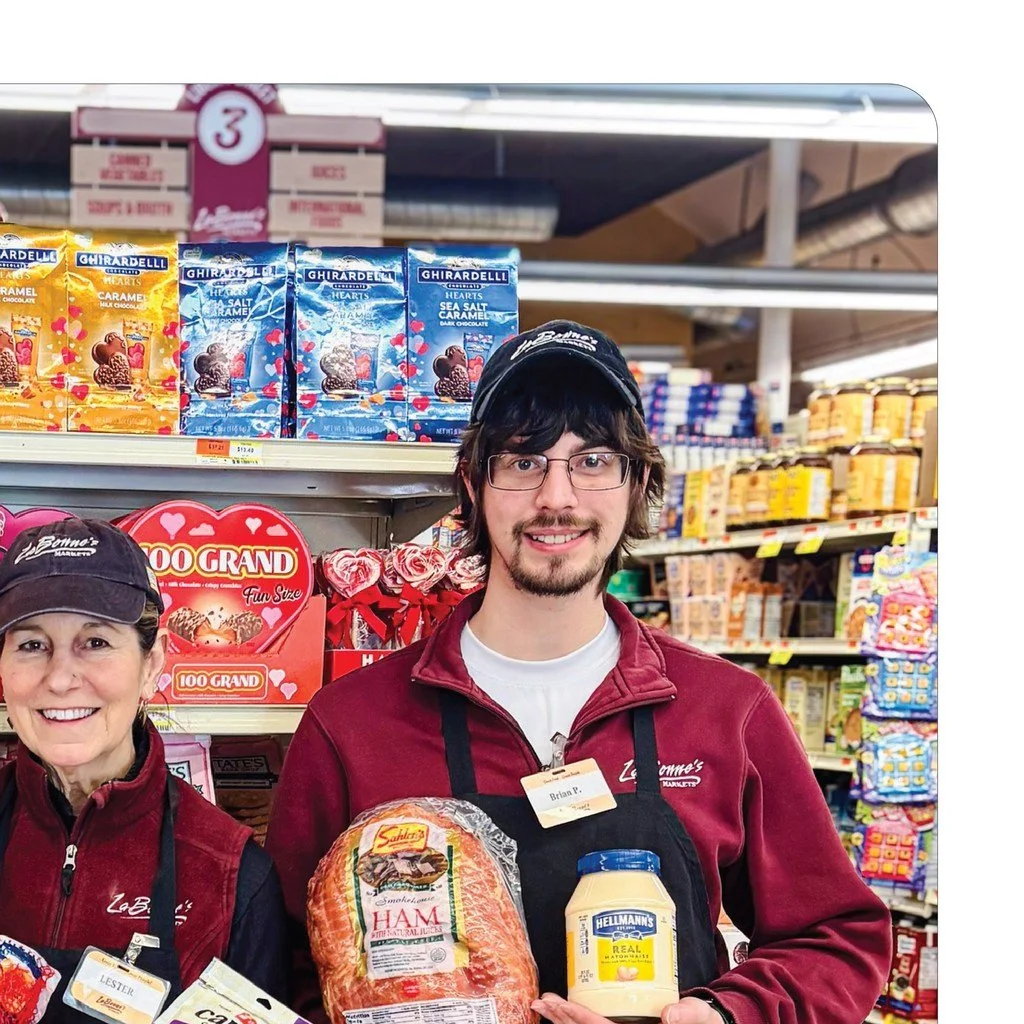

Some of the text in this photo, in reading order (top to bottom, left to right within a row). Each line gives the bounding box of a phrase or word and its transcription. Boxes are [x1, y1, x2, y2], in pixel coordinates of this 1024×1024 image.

[215, 107, 247, 149] 3
[78, 254, 166, 270] GHIRARDELLI
[308, 269, 395, 283] GHIRARDELLI
[422, 271, 507, 281] GHIRARDELLI
[332, 291, 369, 300] HEARTS
[445, 292, 483, 300] HEARTS
[228, 299, 253, 308] SALT
[440, 302, 488, 311] SEA SALT
[439, 311, 489, 320] CARAMEL
[199, 548, 295, 575] GRAND
[243, 583, 302, 606] Fun Size
[179, 673, 260, 688] 100 GRAND
[549, 786, 583, 801] Brian P.
[372, 906, 441, 932] HAM
[596, 914, 654, 929] HELLMANN'S
[387, 929, 419, 938] NATURAL
[613, 945, 641, 954] REAL
[100, 974, 135, 997] LESTER
